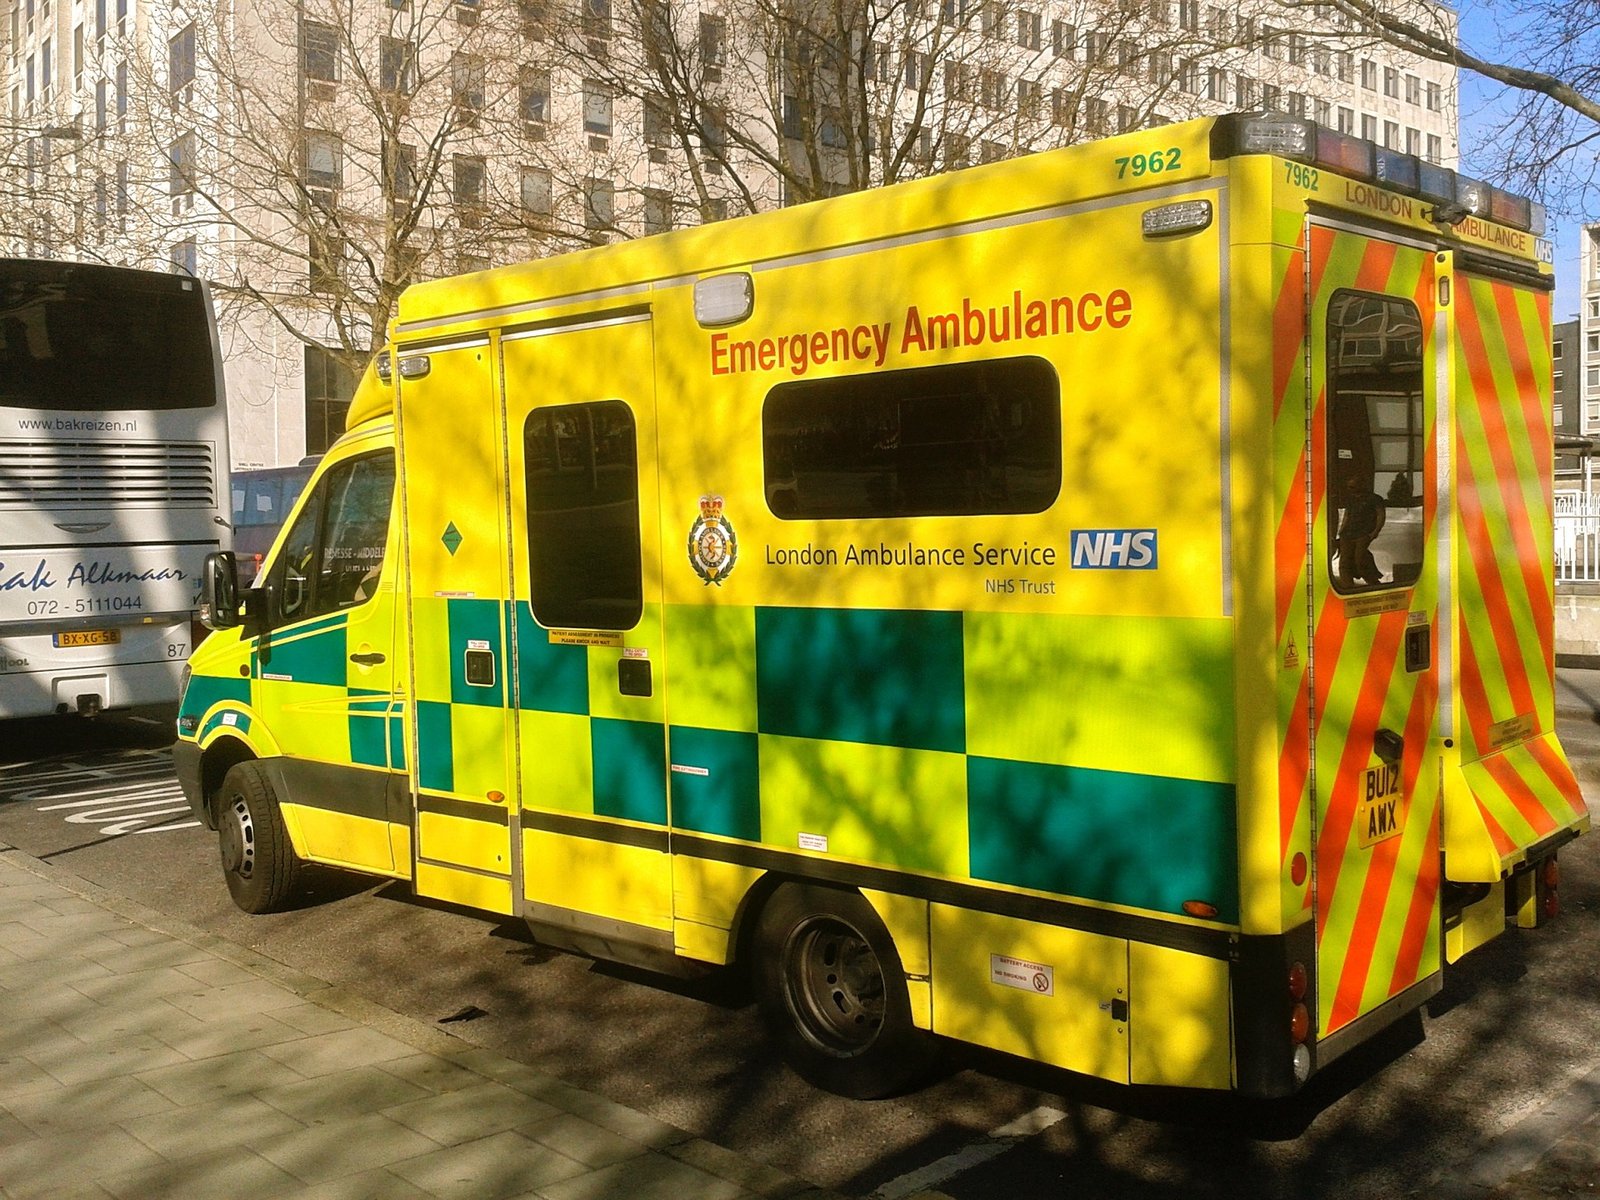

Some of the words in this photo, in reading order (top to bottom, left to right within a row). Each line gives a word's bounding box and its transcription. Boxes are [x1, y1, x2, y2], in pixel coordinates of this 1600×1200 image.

[1115, 147, 1181, 179] 7962
[1284, 162, 1318, 191] 7962
[1345, 182, 1412, 219] LONDON
[1452, 216, 1526, 251] AMBULANCE
[1535, 239, 1553, 261] NHS
[711, 322, 891, 375] Emergency
[901, 289, 1132, 353] Ambulance
[18, 418, 137, 431] www.bakreizen.nl
[766, 543, 837, 566] London
[846, 543, 965, 566] Ambulance
[973, 542, 1056, 566] Service
[1073, 533, 1154, 567] NHS
[67, 562, 188, 589] Alkmaar
[986, 579, 1015, 593] NHS
[1019, 579, 1056, 594] Trust
[27, 600, 58, 616] 072
[75, 596, 142, 613] 5111044
[167, 644, 186, 657] 87
[1366, 765, 1398, 802] BU12
[1369, 800, 1396, 839] AWX
[1000, 957, 1022, 967] BATTERY
[1023, 963, 1043, 972] ACCESS
[1003, 971, 1027, 982] SMOKING
